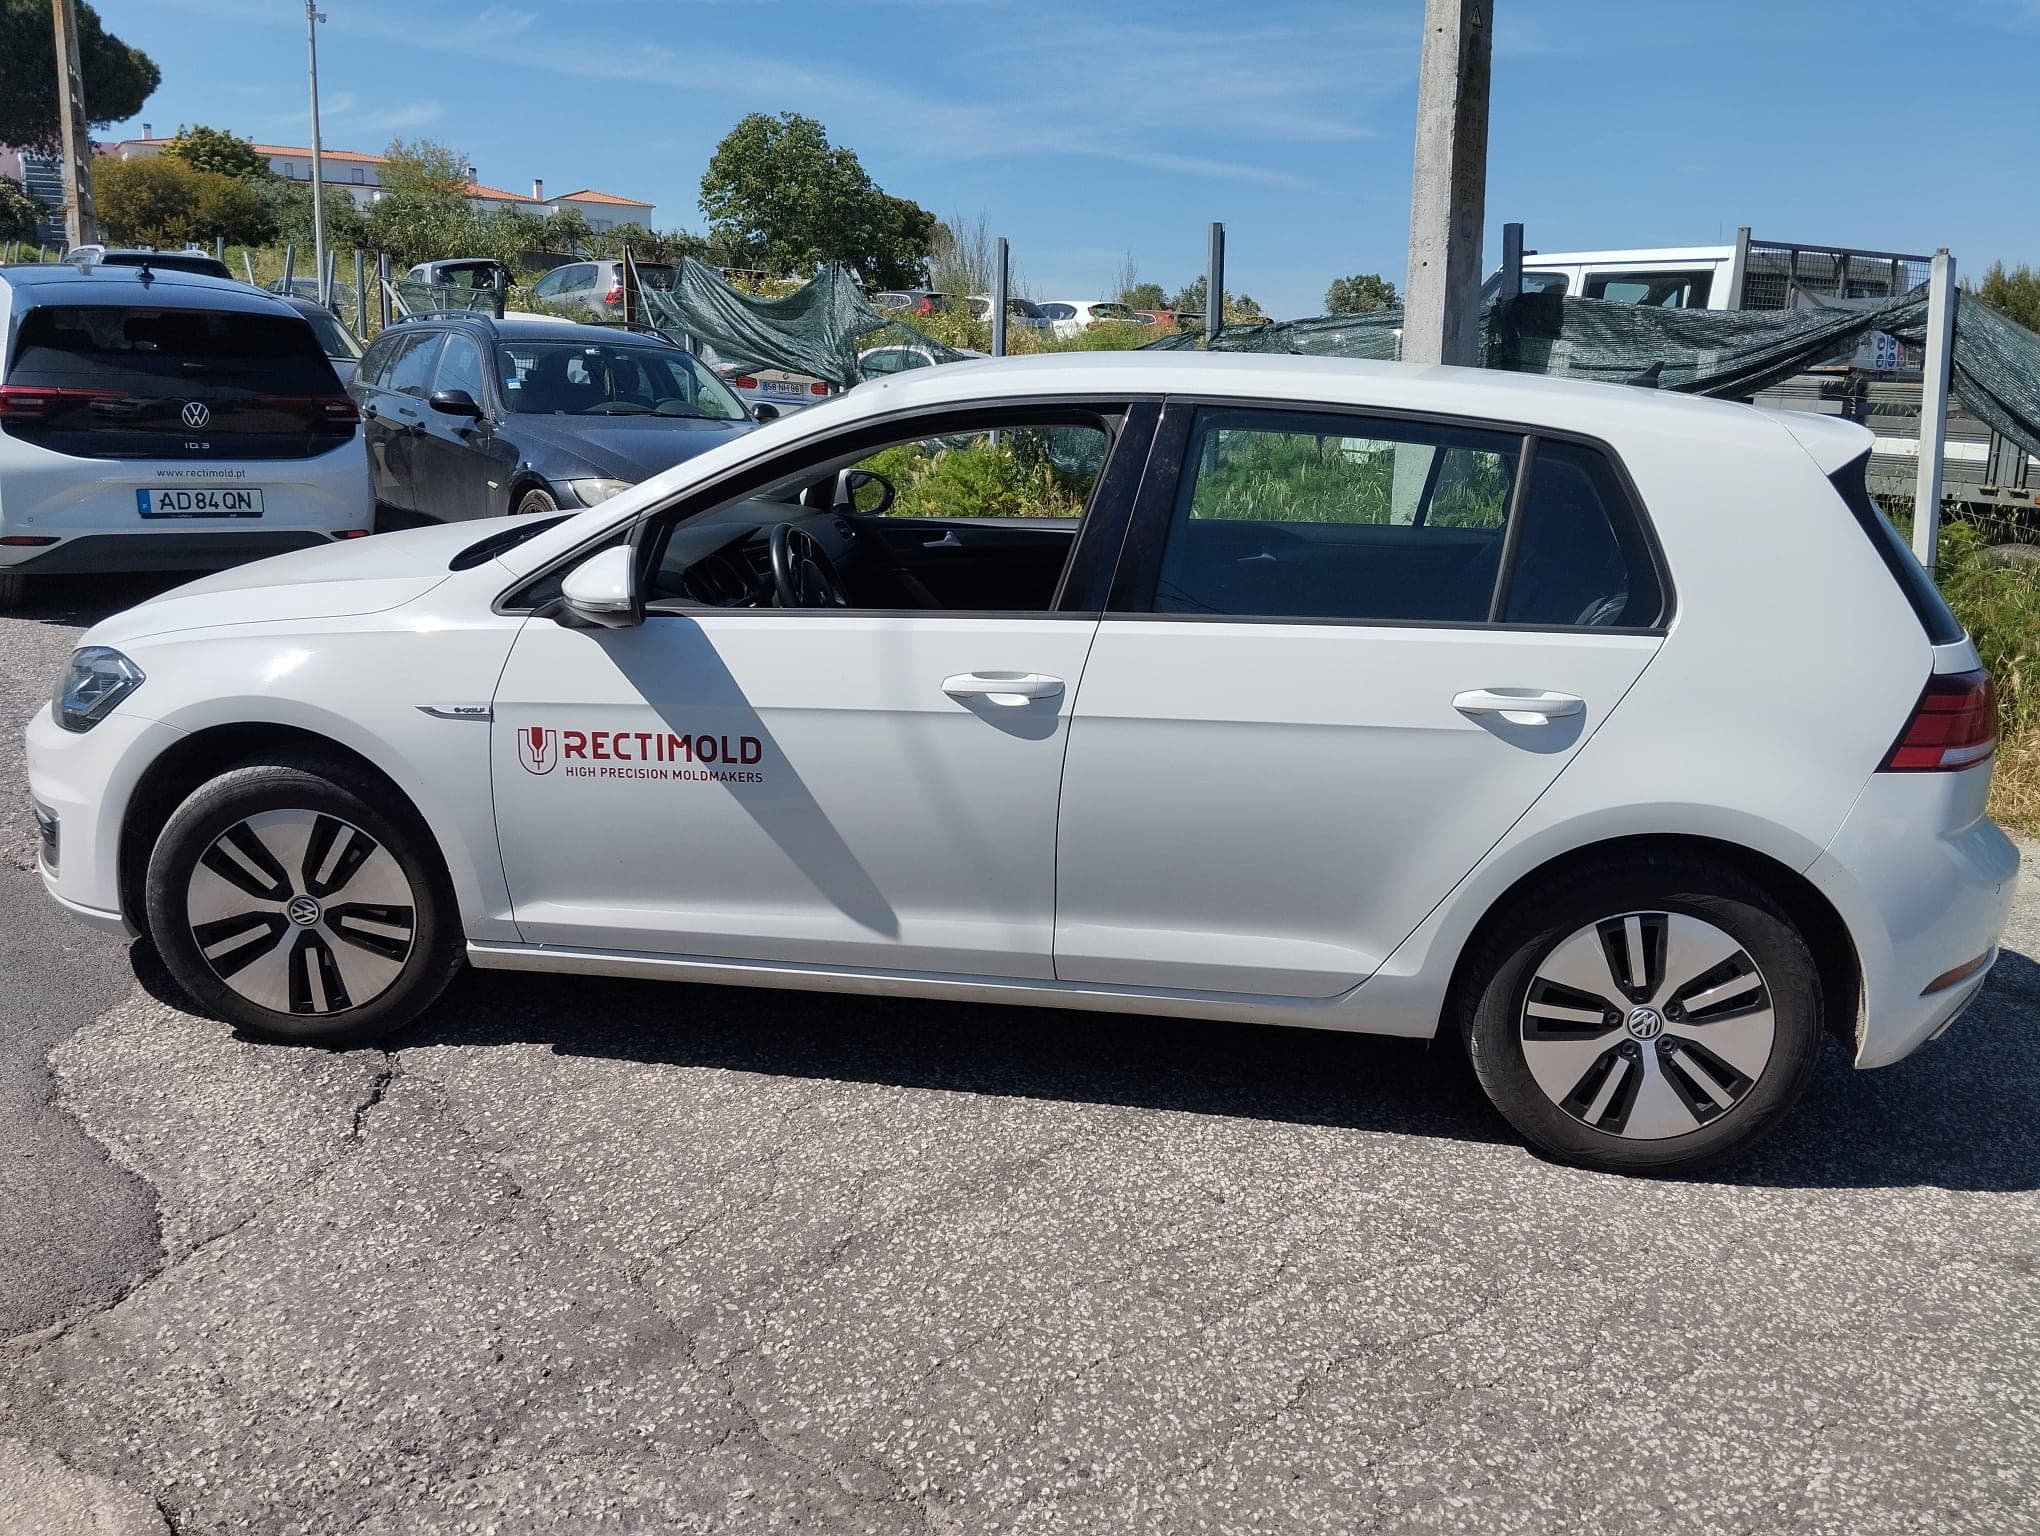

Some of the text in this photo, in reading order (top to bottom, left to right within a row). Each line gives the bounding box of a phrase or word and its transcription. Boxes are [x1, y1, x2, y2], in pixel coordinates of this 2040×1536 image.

[156, 469, 246, 479] www.rectimold.pt
[160, 492, 192, 510] AD
[195, 492, 219, 510] 84
[563, 731, 762, 764] RECTIMOLD
[566, 767, 763, 783] HIGH PRECISION MOLDMAKERS
